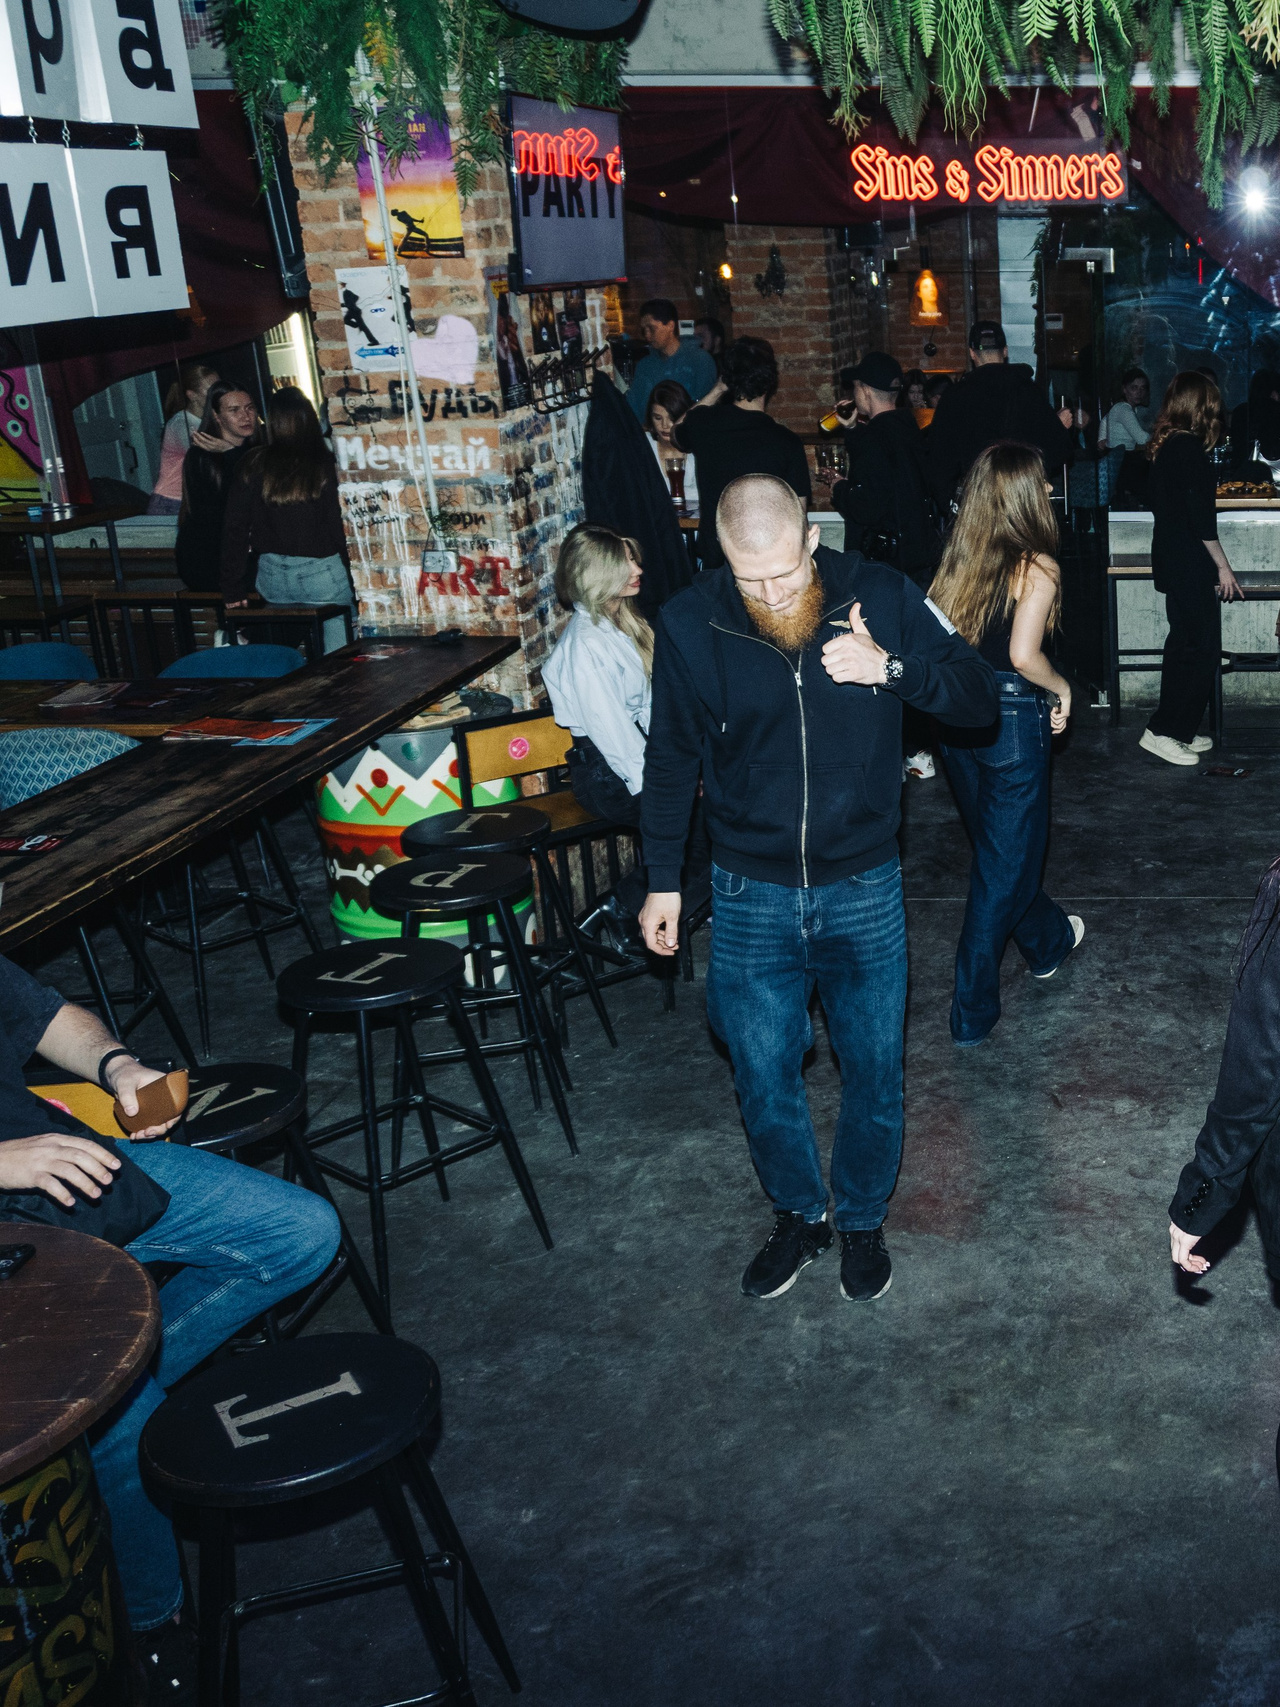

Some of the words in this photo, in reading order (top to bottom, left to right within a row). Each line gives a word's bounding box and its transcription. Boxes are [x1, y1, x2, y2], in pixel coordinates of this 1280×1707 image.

[520, 150, 618, 219] PARTY
[851, 143, 938, 202] Sins
[945, 159, 970, 203] &
[974, 144, 1125, 202] Sinners
[335, 436, 492, 473] Мечтай
[417, 555, 512, 596] ART
